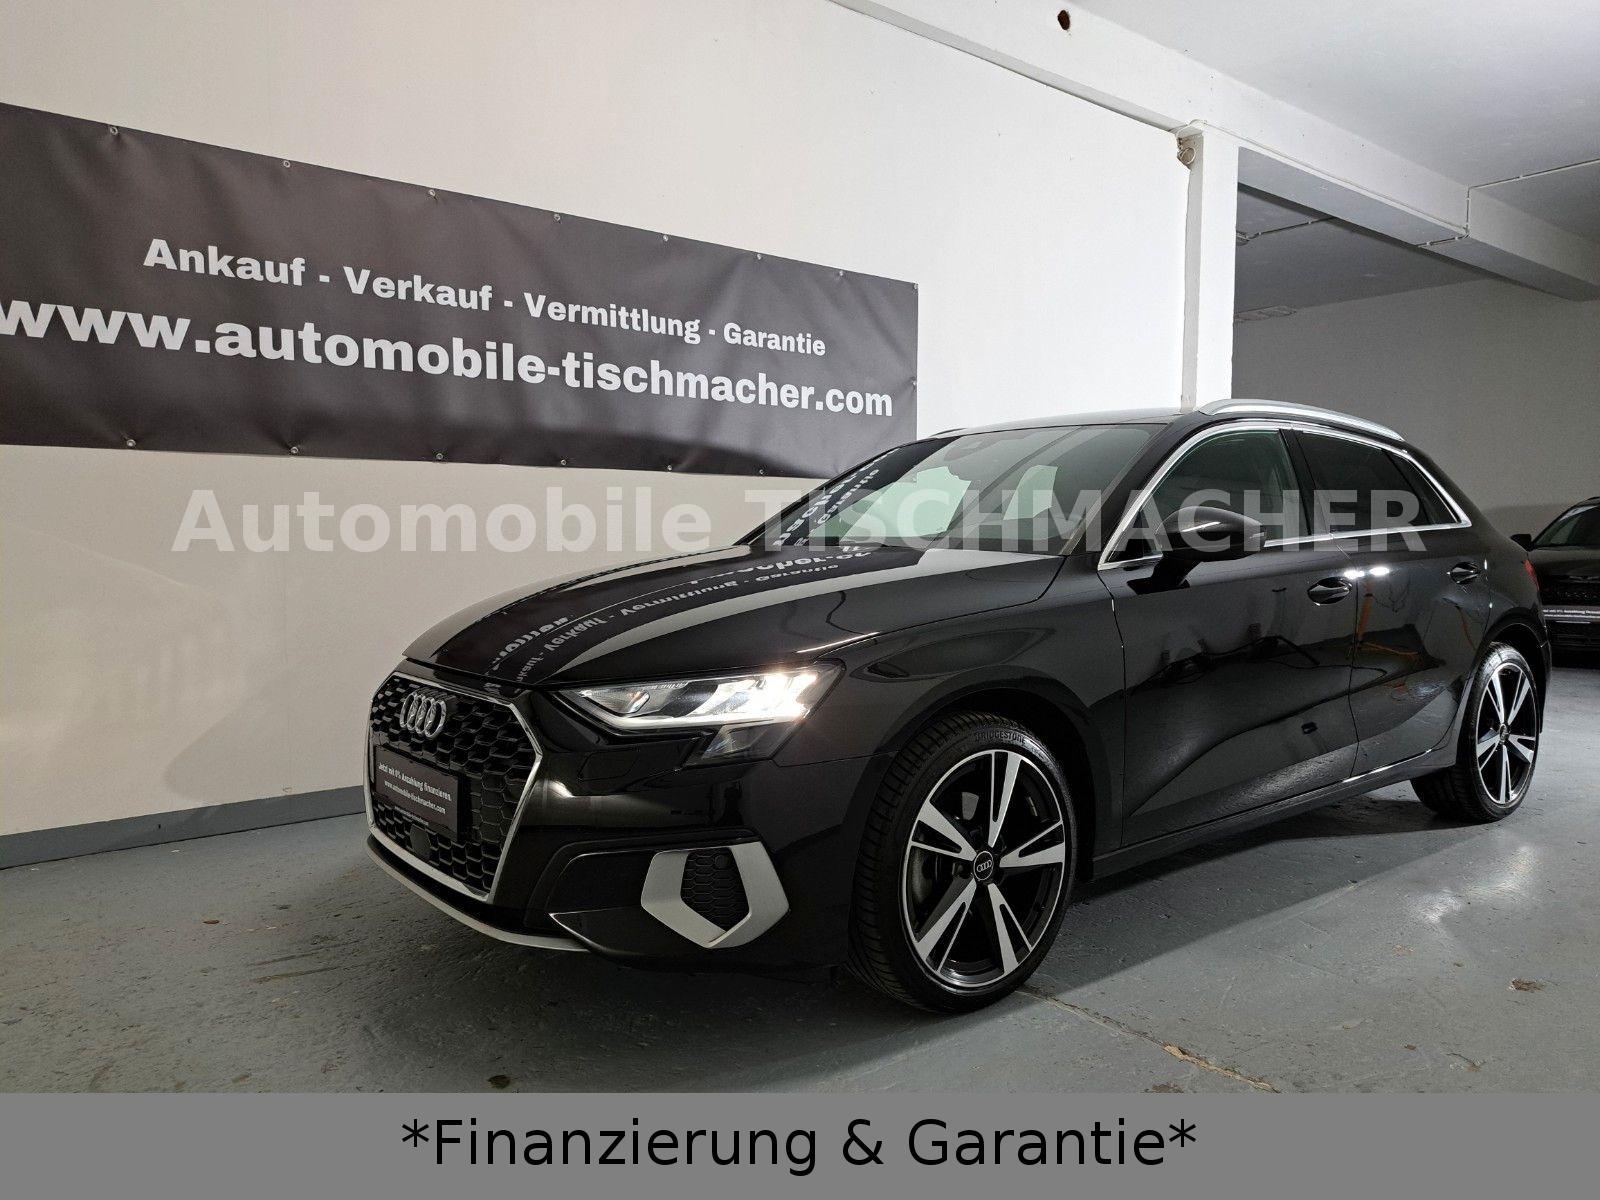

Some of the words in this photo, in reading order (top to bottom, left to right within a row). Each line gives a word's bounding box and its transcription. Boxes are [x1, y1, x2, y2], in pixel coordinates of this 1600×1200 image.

[143, 238, 305, 287] Ankauf
[319, 274, 330, 283] -
[343, 266, 492, 311] Verkauf
[524, 292, 701, 344] Vermittlung
[724, 322, 826, 356] Garantie
[0, 299, 893, 417] www.automobile-tischmacher.com
